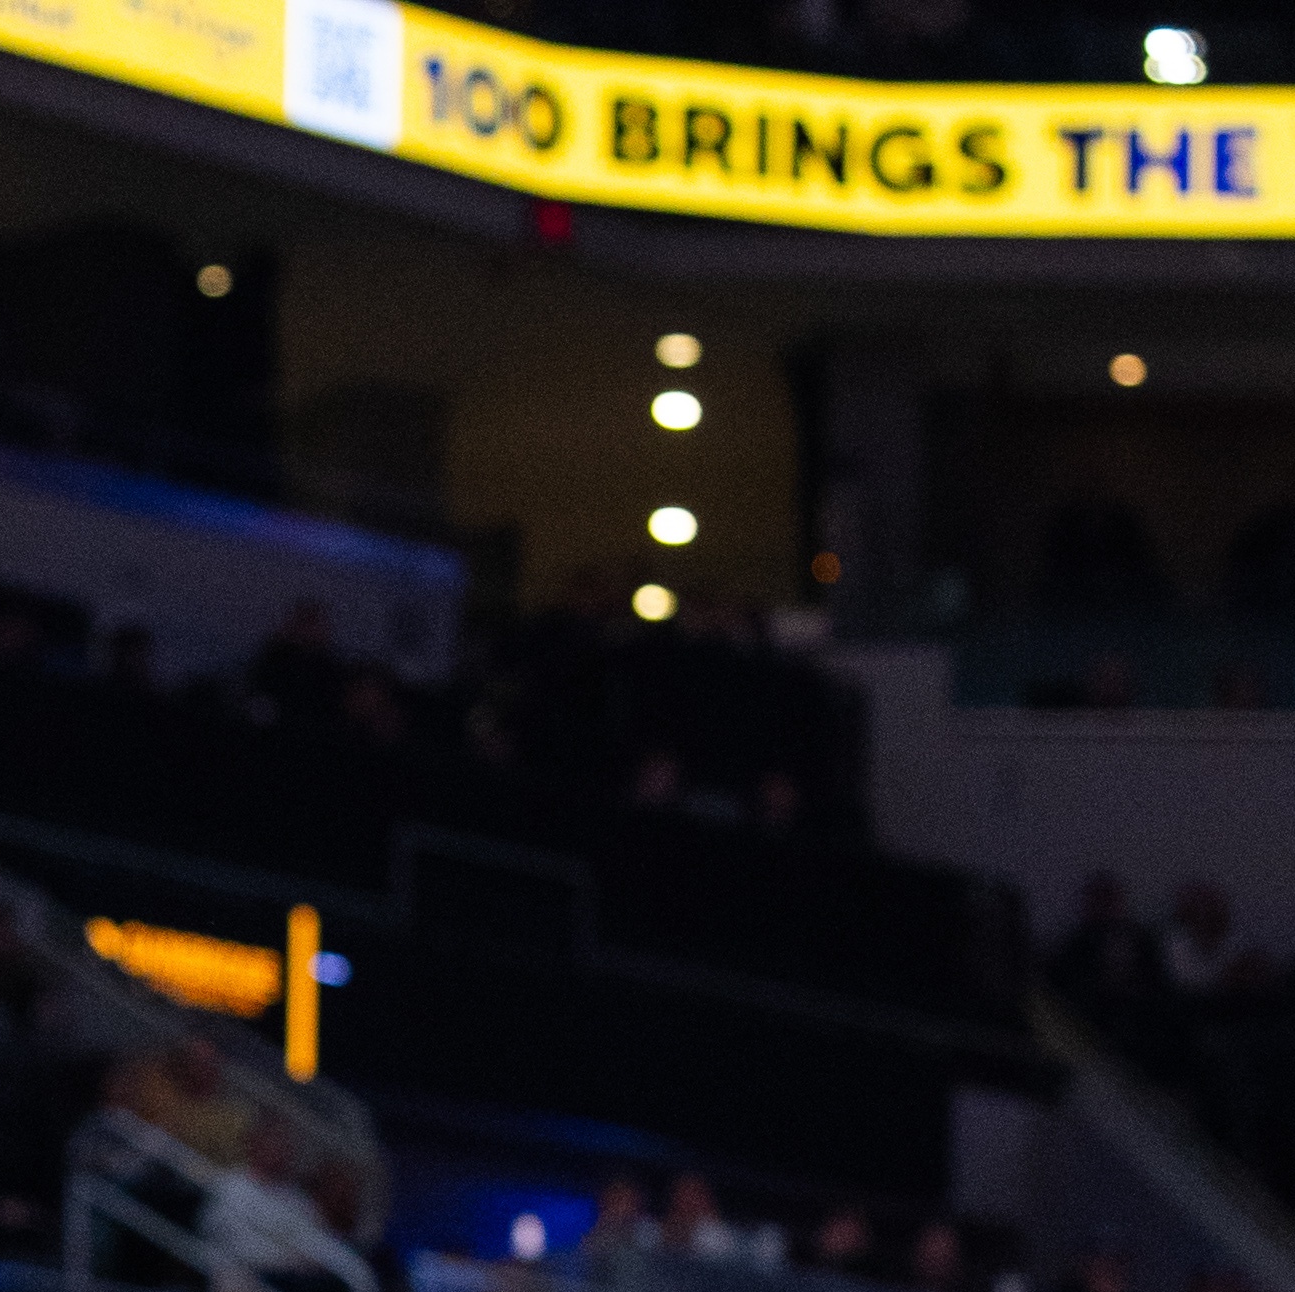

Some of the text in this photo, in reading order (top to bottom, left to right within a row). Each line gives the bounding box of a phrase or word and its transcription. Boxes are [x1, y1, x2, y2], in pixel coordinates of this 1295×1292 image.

[422, 55, 1257, 197] 100 BRINGS THE
